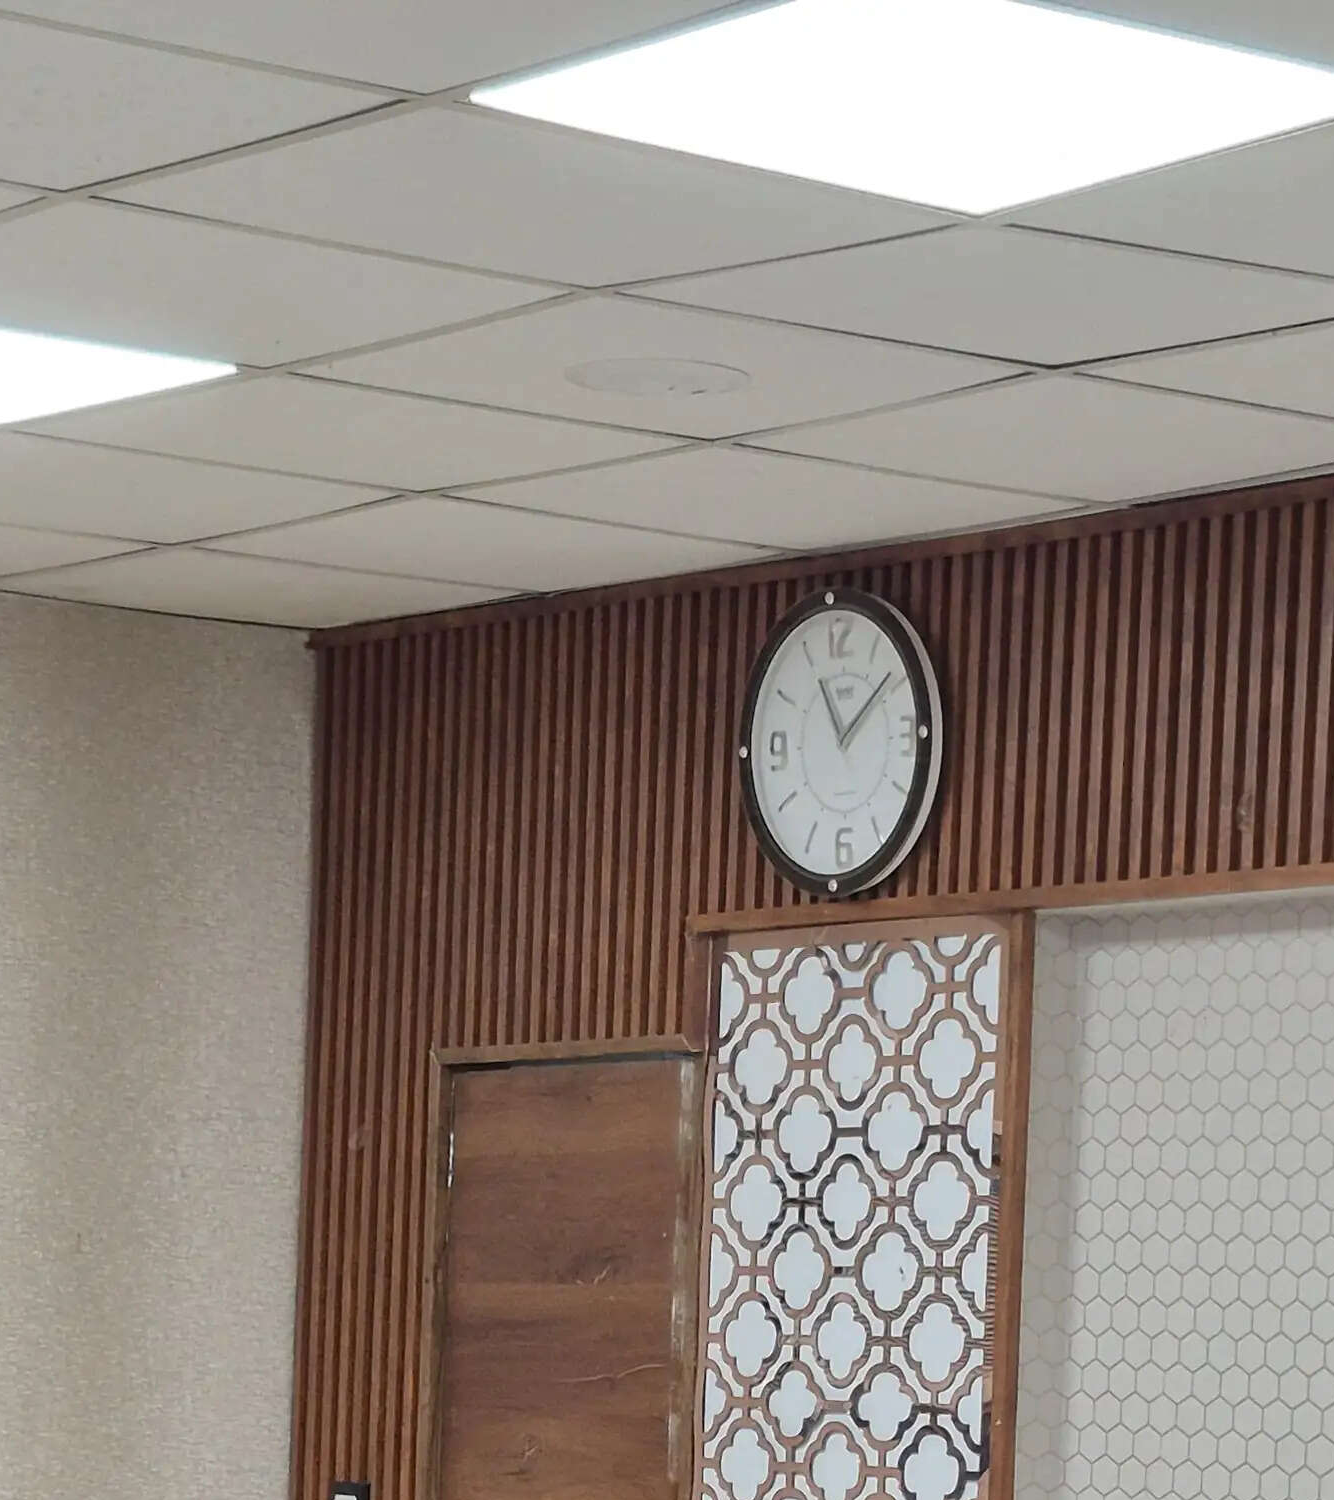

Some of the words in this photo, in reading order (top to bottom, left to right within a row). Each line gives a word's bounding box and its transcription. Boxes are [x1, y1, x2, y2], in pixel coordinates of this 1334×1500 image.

[828, 618, 853, 659] 12
[770, 731, 788, 771] 9
[900, 715, 914, 757] 3
[835, 828, 853, 868] 6
